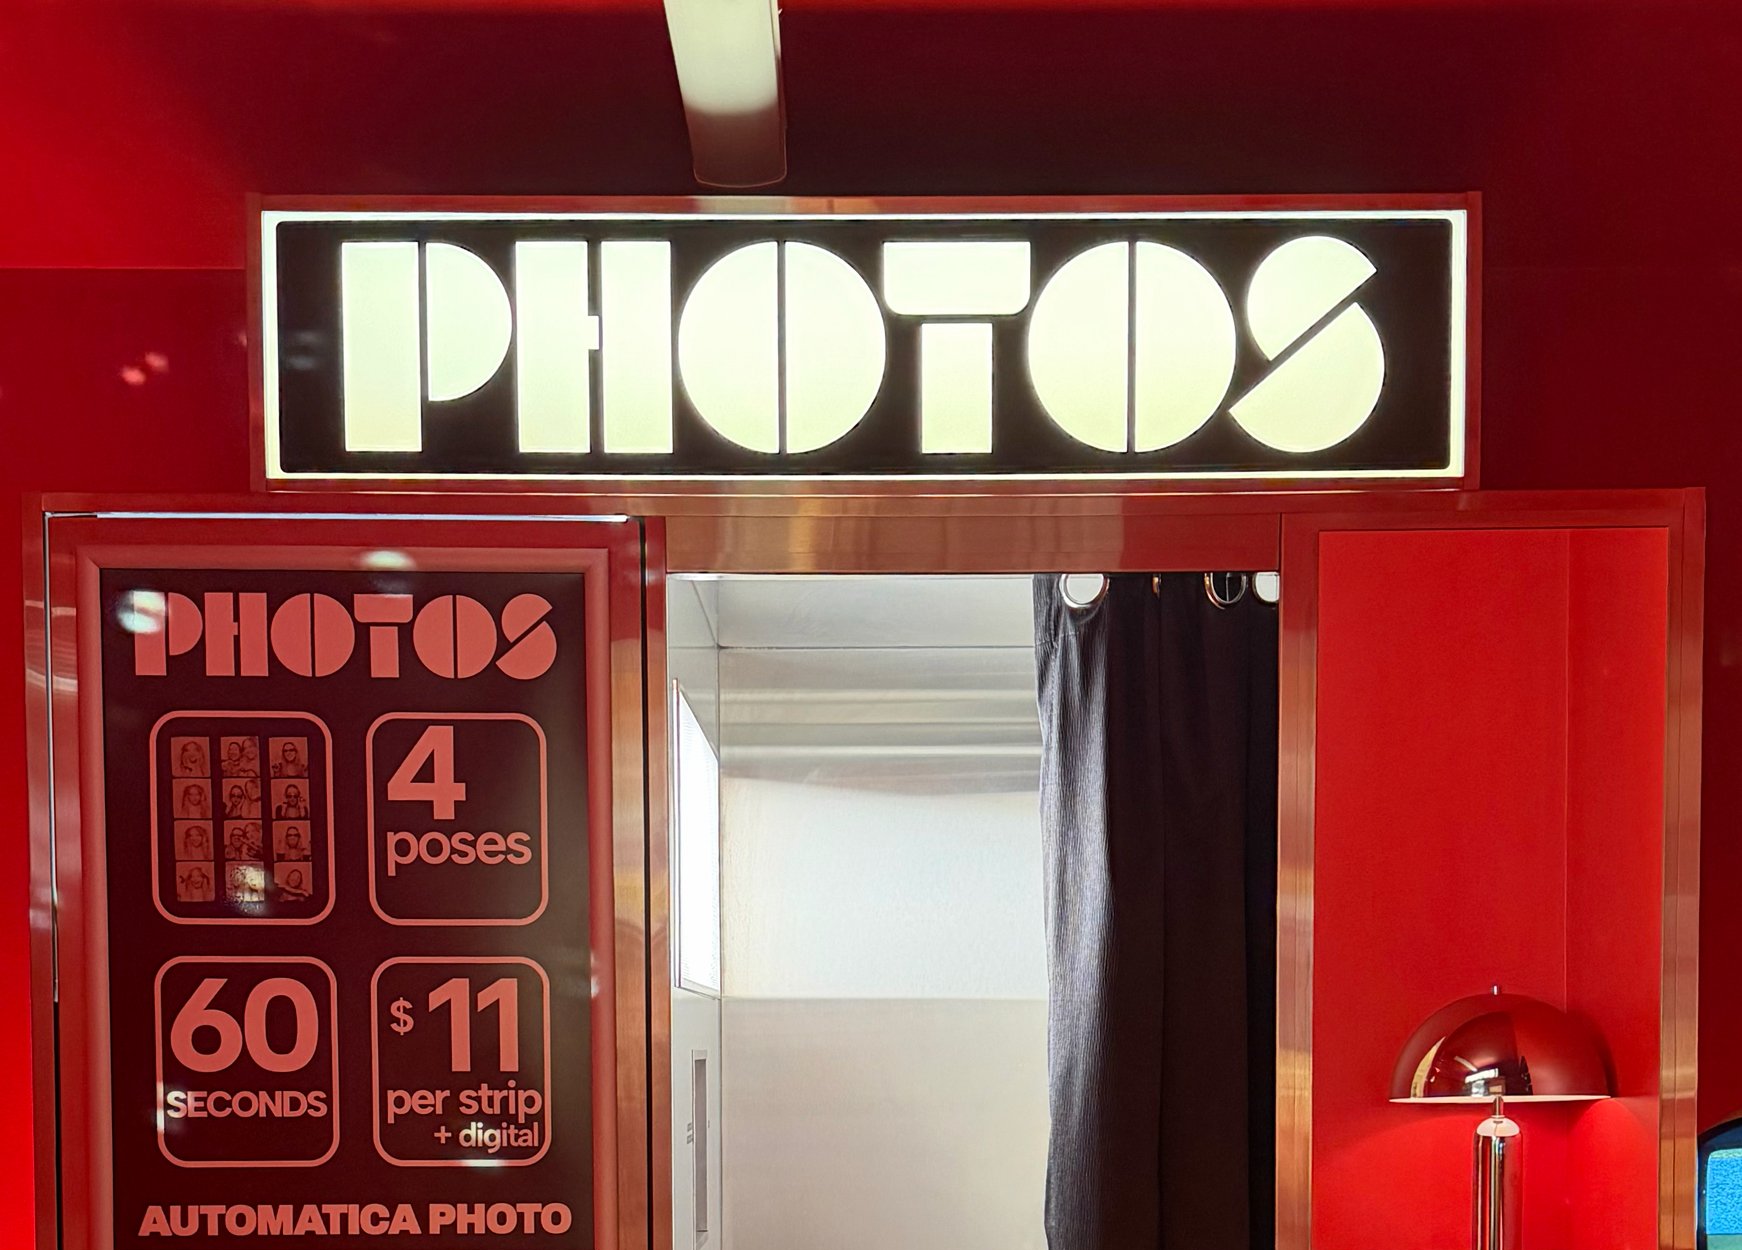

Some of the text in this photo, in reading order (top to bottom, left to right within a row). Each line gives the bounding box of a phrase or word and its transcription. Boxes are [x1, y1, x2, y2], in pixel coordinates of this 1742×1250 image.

[341, 236, 1385, 454] PHOTOS
[134, 591, 557, 680] PHOTOS
[387, 725, 467, 820] 4
[387, 832, 532, 876] poses
[170, 977, 319, 1073] 60
[166, 1090, 327, 1119] SECONDS
[388, 1080, 543, 1123] per strip
[459, 1122, 540, 1152] digital
[138, 1202, 572, 1237] AUTOMATICA PHOTO
